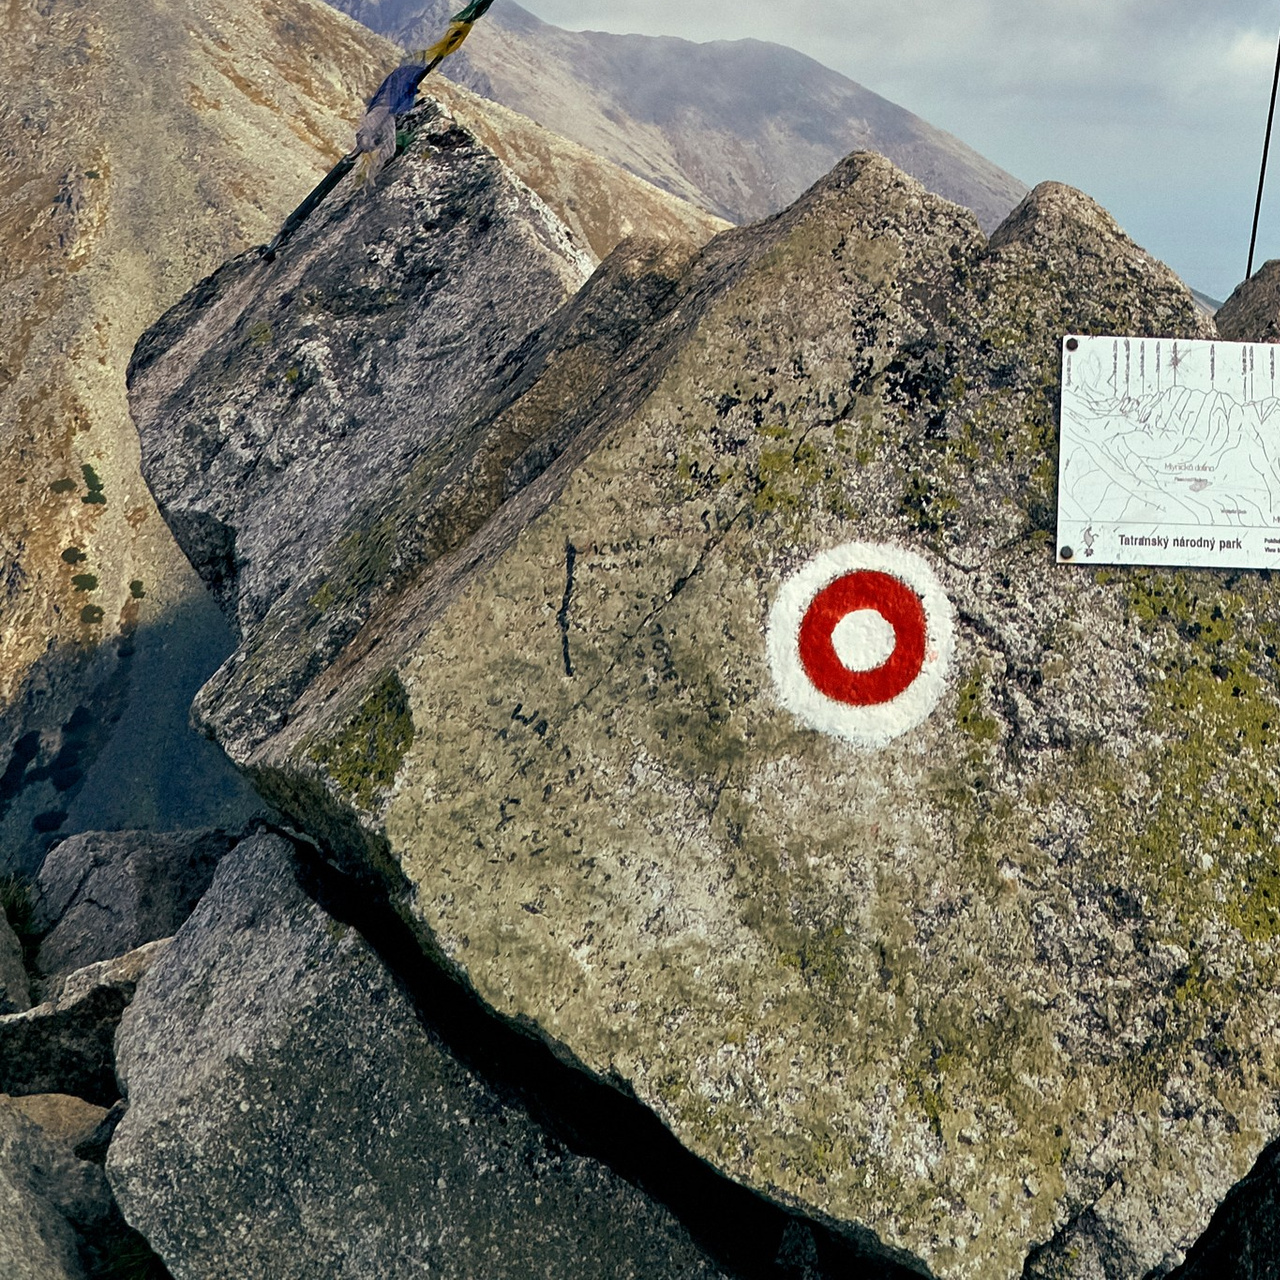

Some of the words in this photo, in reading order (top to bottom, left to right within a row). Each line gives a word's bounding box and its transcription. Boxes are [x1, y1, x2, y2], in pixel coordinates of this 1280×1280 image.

[1119, 534, 1168, 549] Tatranský
[1173, 536, 1215, 551] národný
[1219, 538, 1242, 551] park
